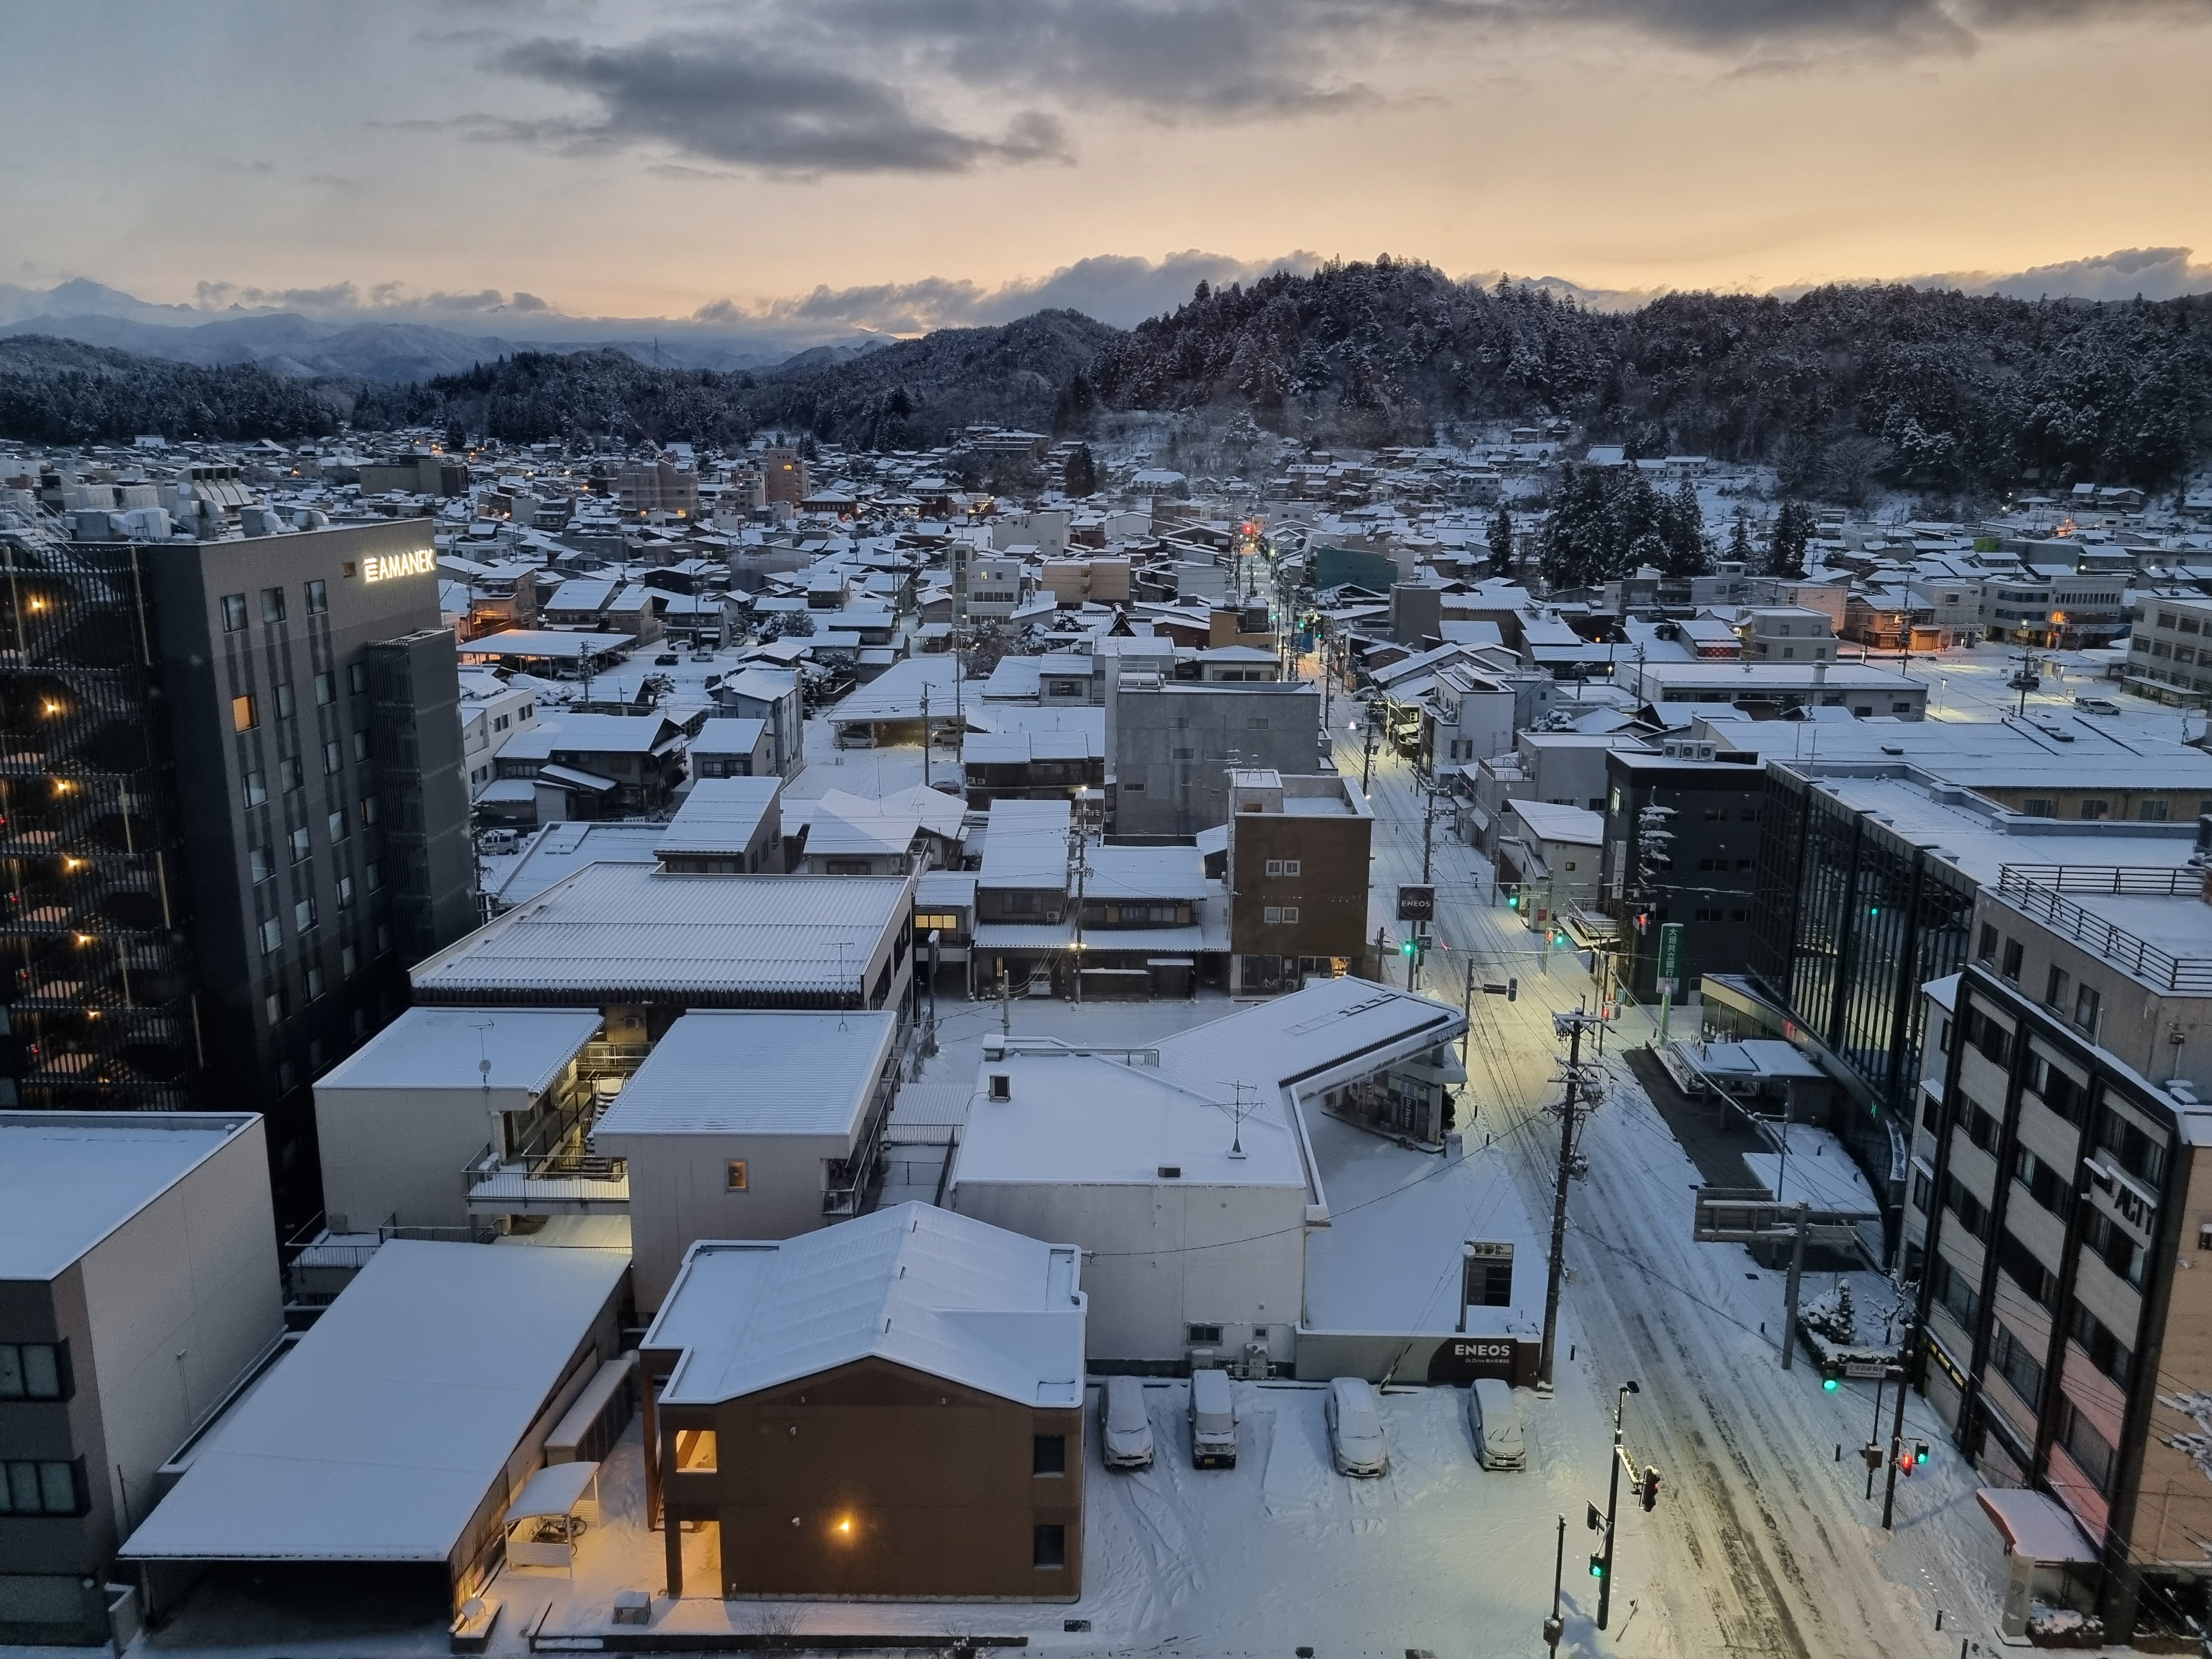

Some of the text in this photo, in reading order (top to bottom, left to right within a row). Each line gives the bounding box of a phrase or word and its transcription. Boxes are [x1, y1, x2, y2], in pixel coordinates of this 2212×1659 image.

[379, 549, 436, 580] AMANEK
[1665, 928, 1678, 977] 大垣共立銀行
[1455, 1344, 1510, 1357] ENEOS
